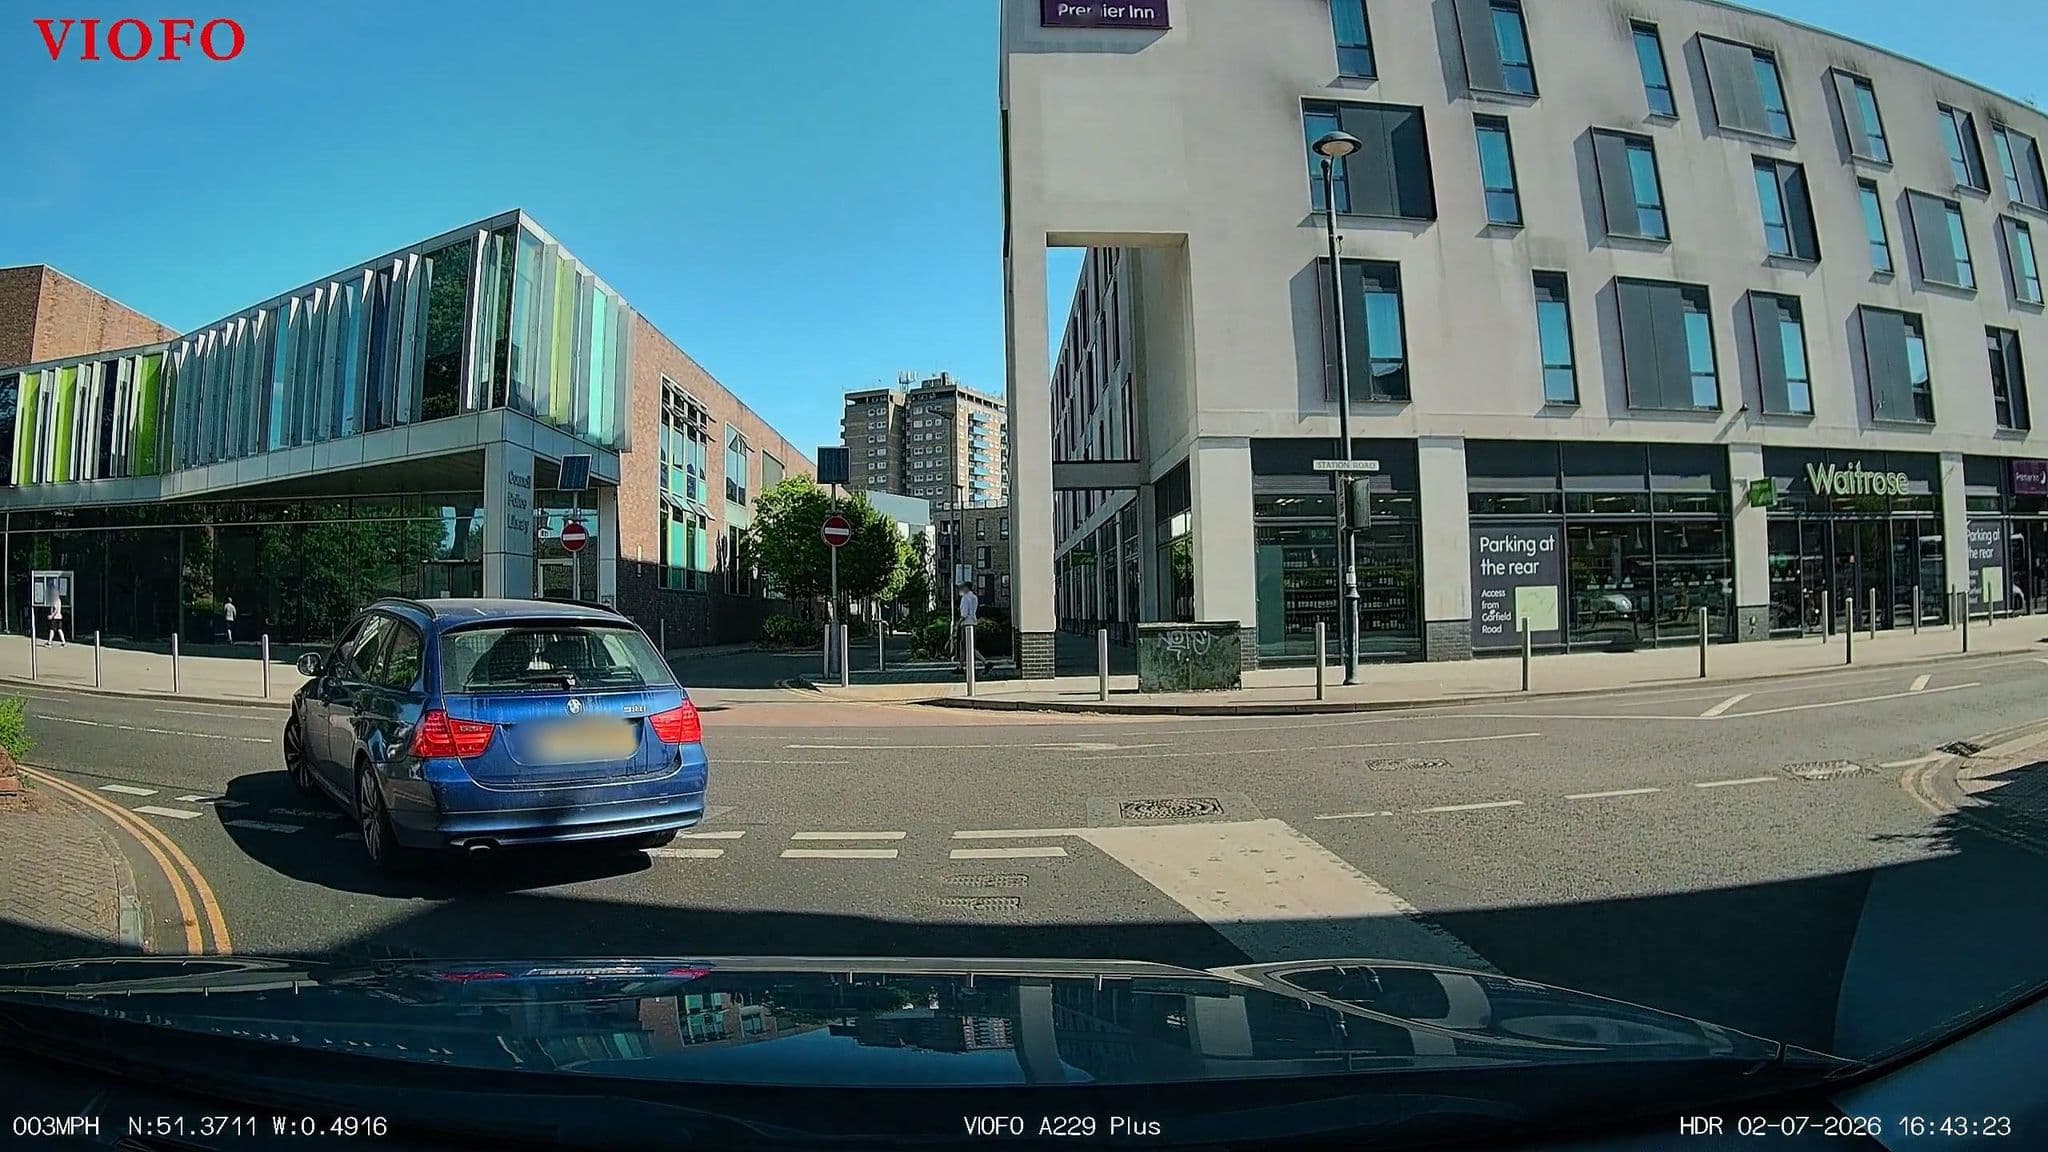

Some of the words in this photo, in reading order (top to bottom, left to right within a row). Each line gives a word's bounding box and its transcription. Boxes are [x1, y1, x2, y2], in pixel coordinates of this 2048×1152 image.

[1128, 5, 1155, 19] Inn
[1315, 461, 1350, 469] STATION
[1352, 461, 1377, 470] ROAD
[508, 470, 531, 489] Council
[1806, 460, 1910, 496] Waitrose
[1480, 534, 1537, 557] Parking
[1539, 534, 1555, 552] at
[1480, 558, 1506, 576] the
[1508, 562, 1540, 575] rear
[1481, 589, 1506, 598] Access
[1481, 600, 1500, 609] from
[1481, 611, 1512, 622] Garfield
[1481, 624, 1503, 634] Road
